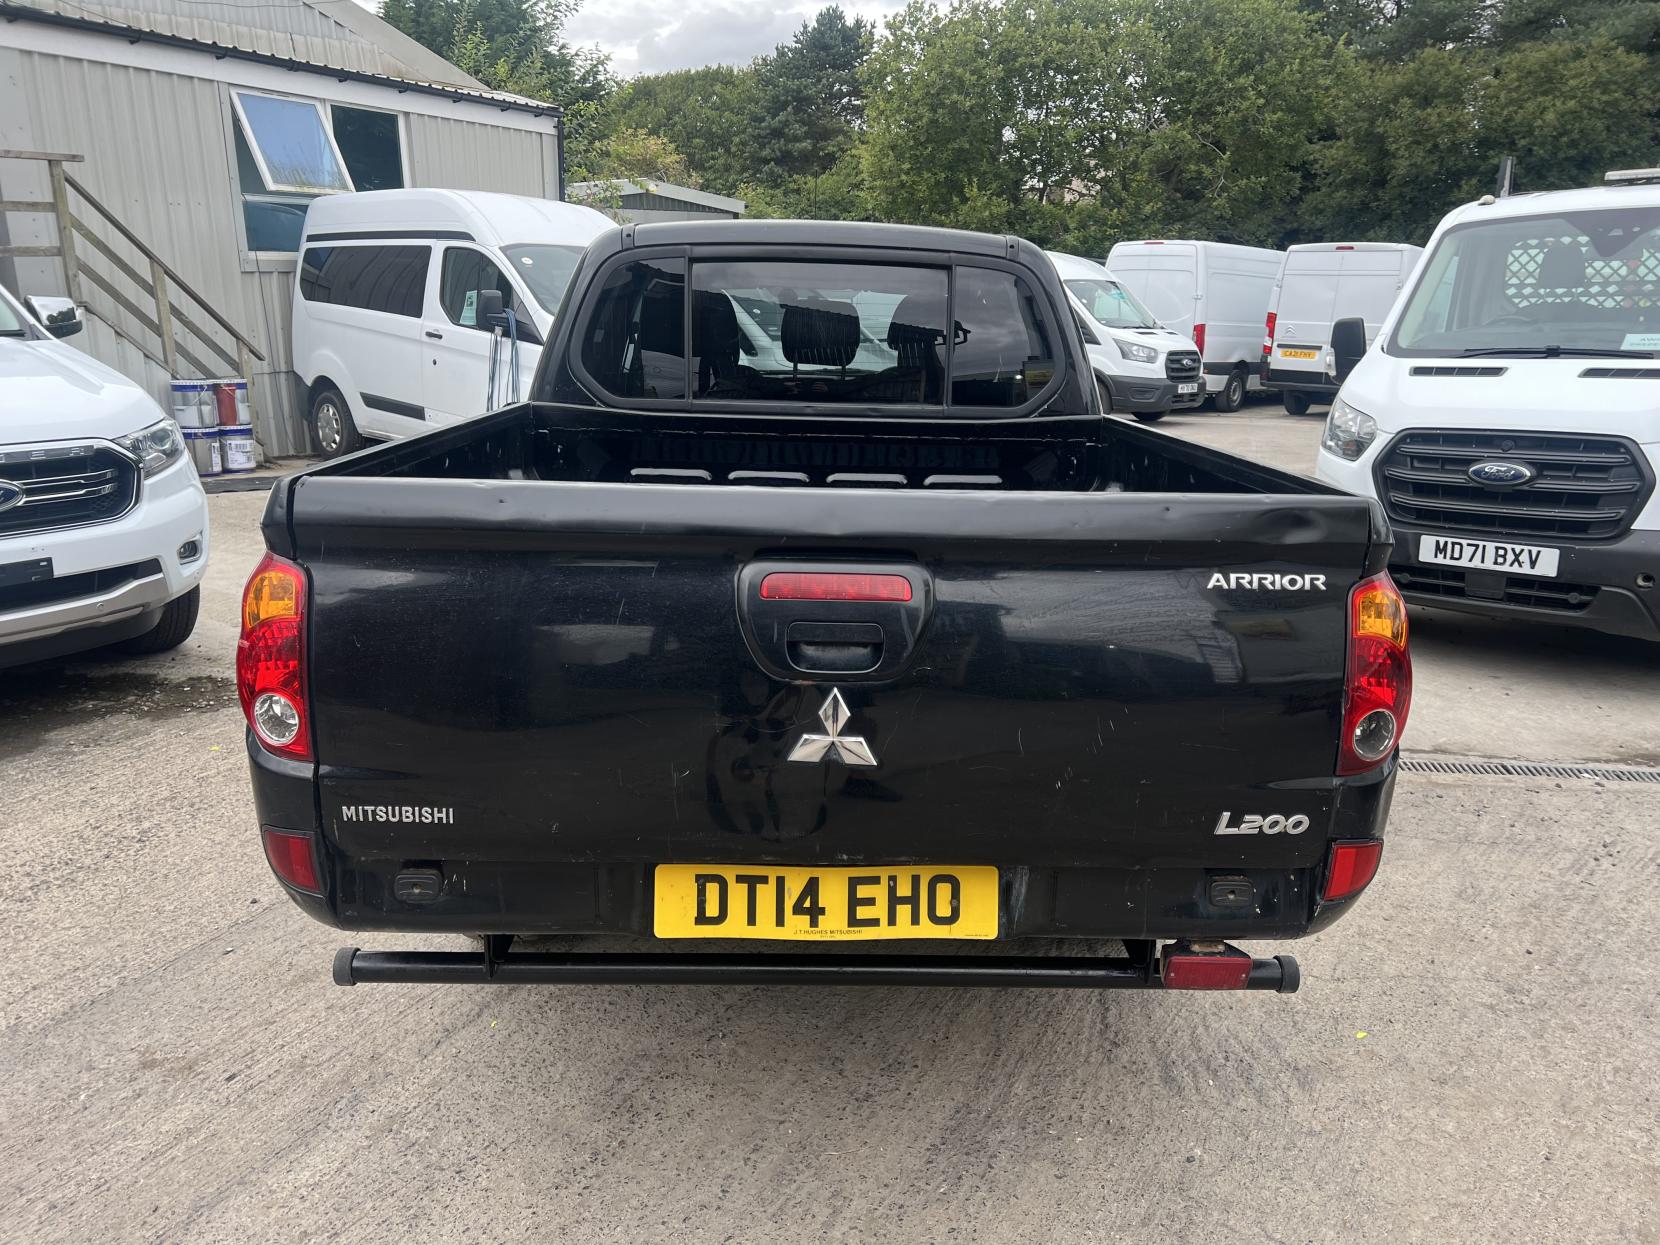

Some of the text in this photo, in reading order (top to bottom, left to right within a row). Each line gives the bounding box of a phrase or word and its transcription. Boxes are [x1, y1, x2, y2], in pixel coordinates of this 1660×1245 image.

[1481, 465, 1516, 480] Ford
[1434, 540, 1542, 570] MD71 BXV
[1207, 573, 1327, 591] ARRIOR
[342, 806, 454, 824] MITSUBISHI
[1214, 812, 1310, 835] L200
[694, 873, 961, 929] DT14 EHO
